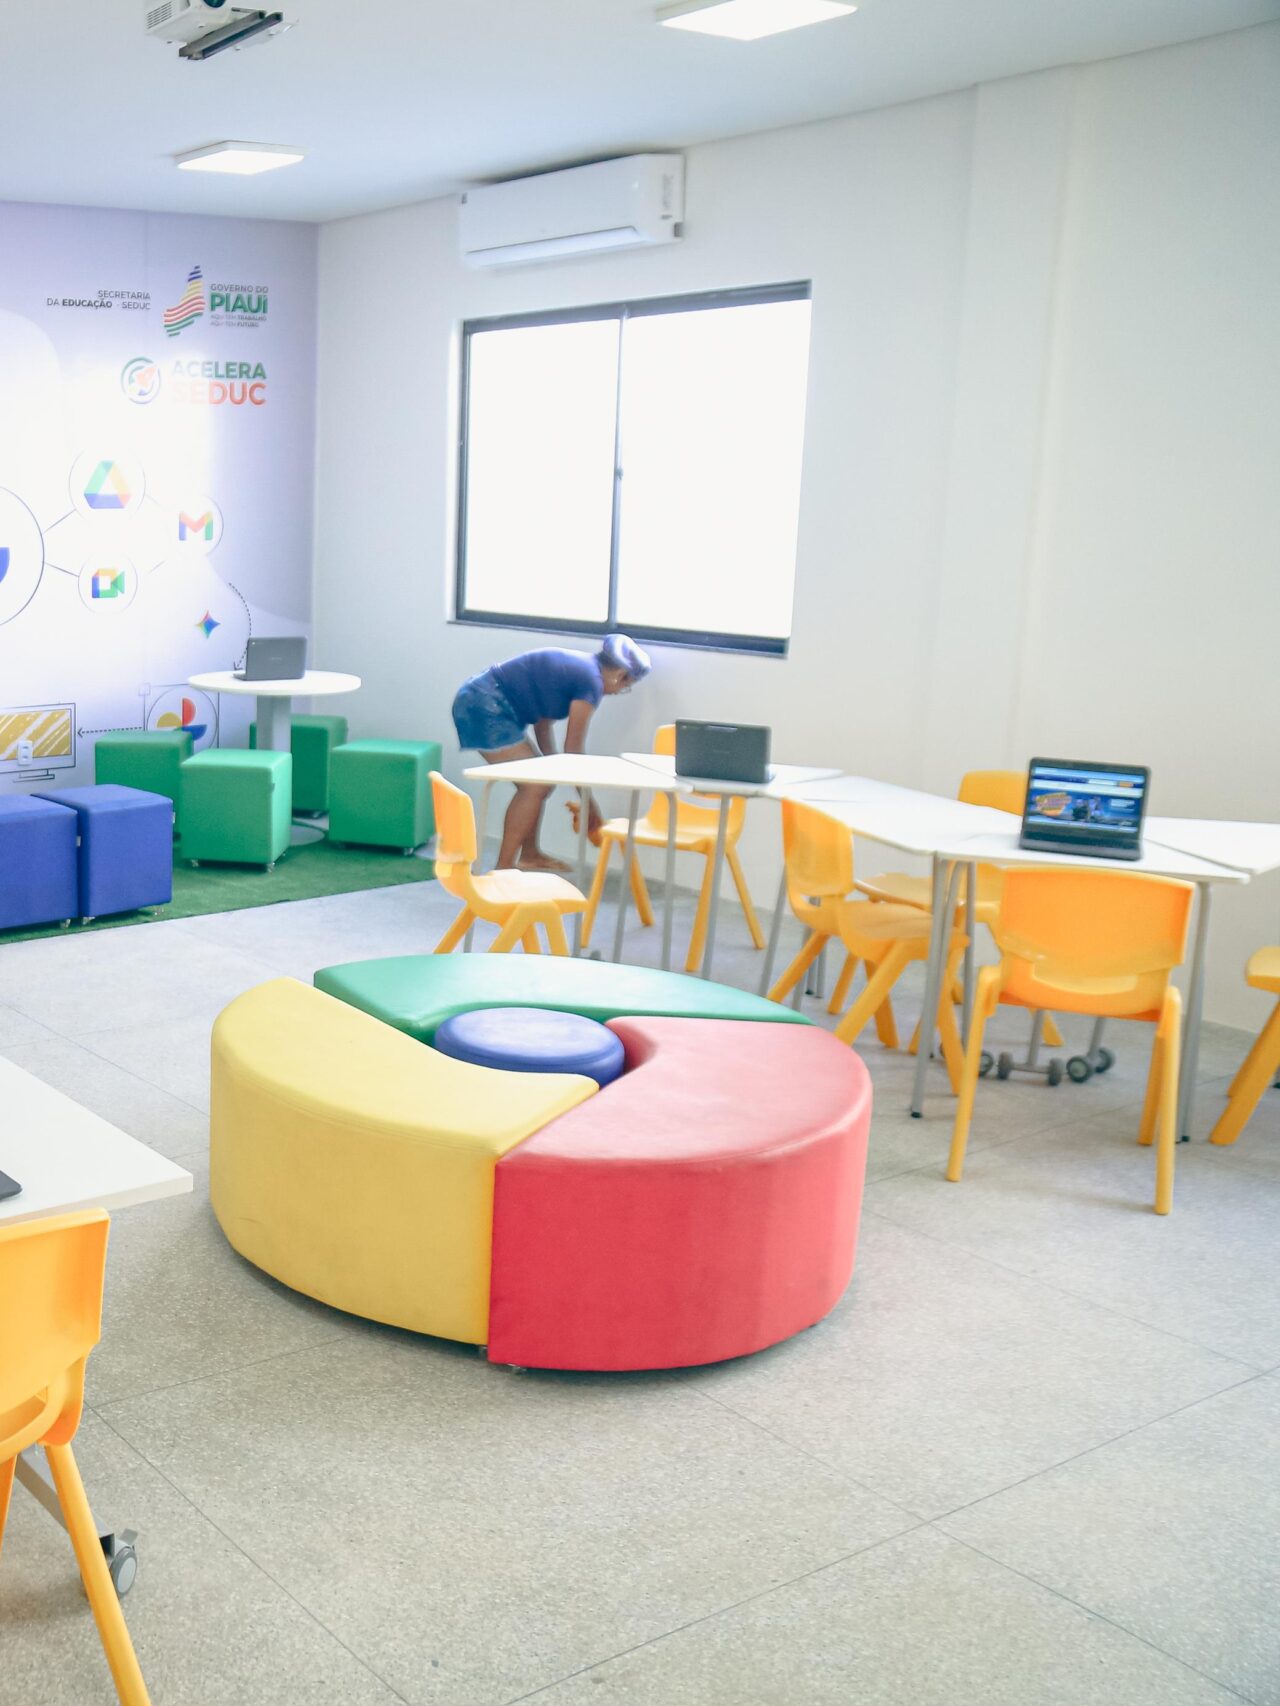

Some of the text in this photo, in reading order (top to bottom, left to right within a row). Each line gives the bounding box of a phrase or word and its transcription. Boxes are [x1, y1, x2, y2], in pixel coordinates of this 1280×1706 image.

[210, 284, 254, 292] GOVERNO
[97, 290, 151, 300] SECRETARIA
[47, 298, 151, 310] DA EDUCAÇÃO SEDUC
[172, 361, 267, 379] ACELERA
